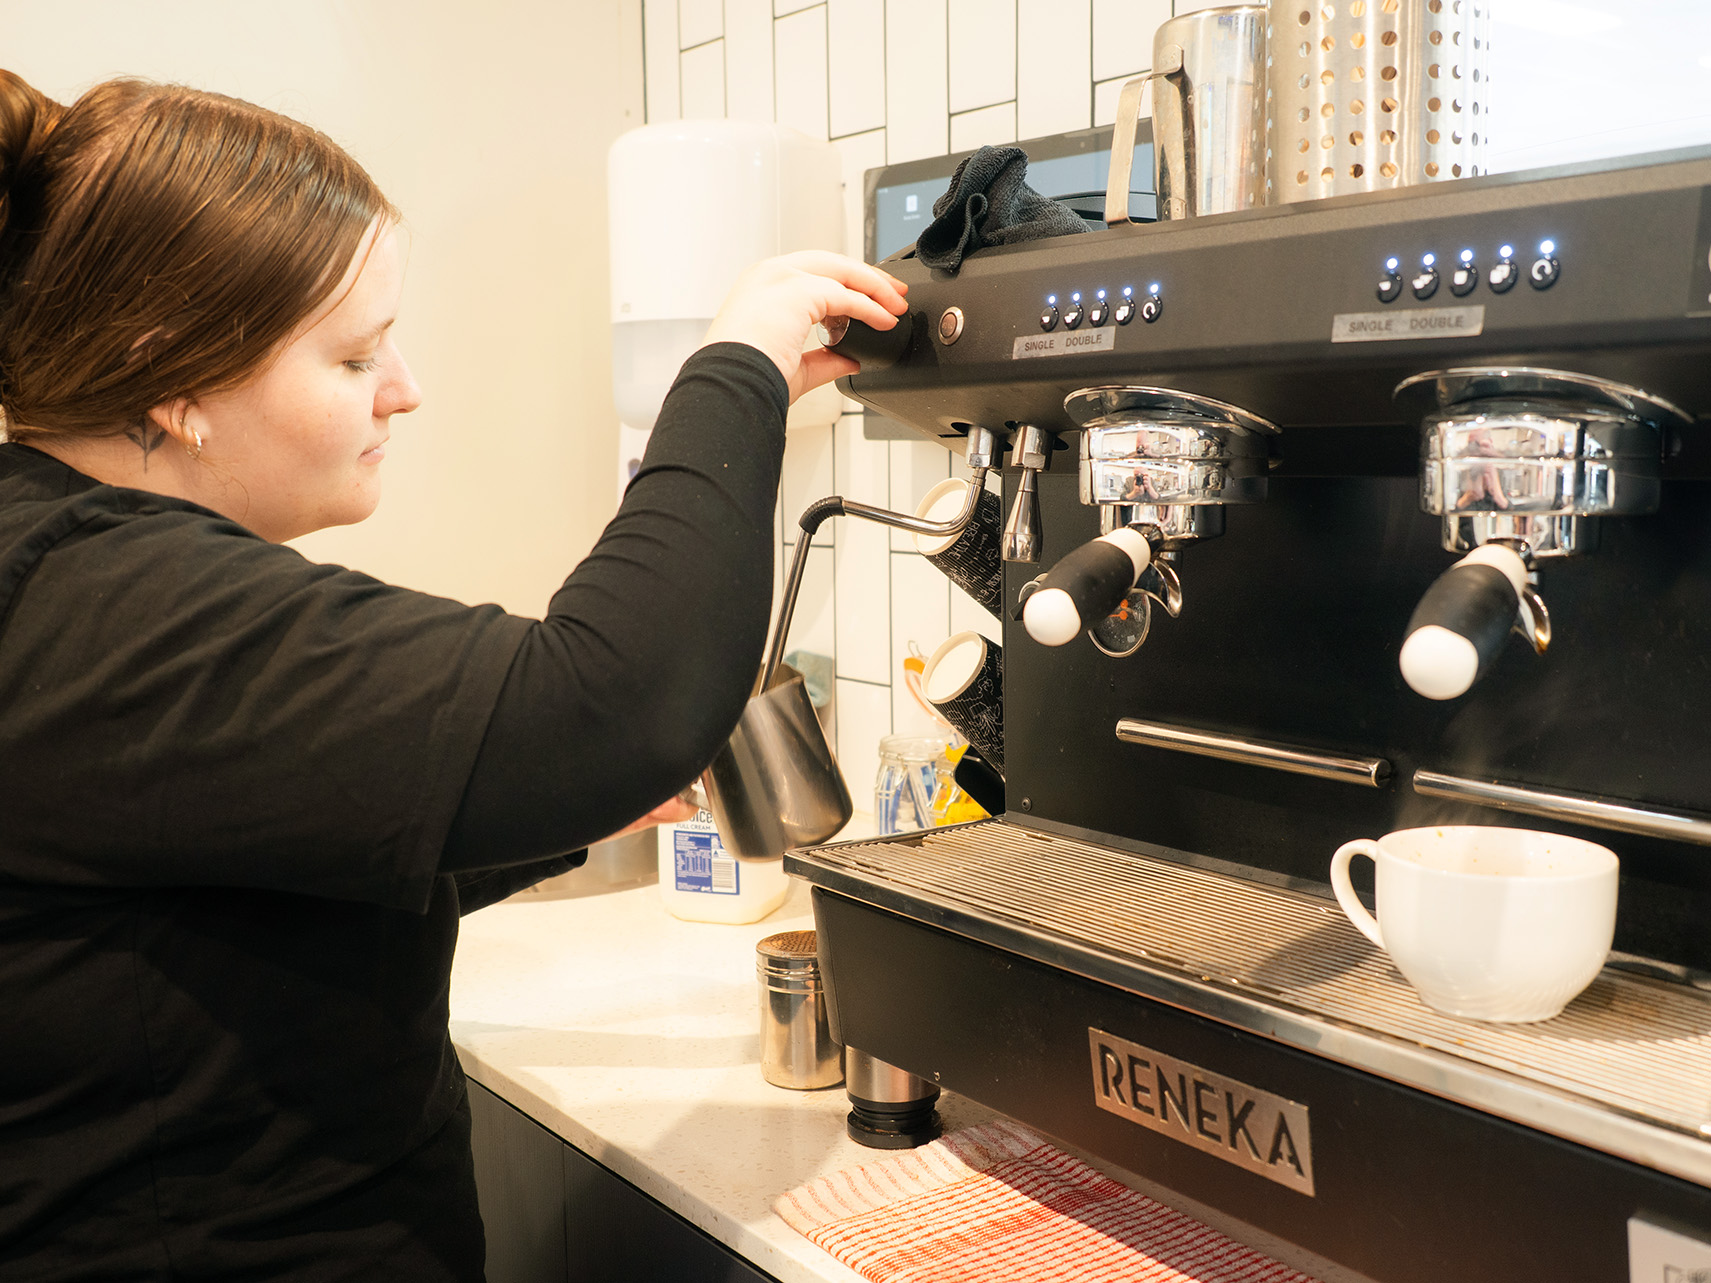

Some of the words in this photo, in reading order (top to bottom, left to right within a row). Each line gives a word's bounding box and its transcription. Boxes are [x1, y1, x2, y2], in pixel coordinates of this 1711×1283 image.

[1349, 319, 1393, 333] SINGLE
[1410, 315, 1463, 330] DOUBLE
[1024, 339, 1054, 351] SINGLE
[1065, 334, 1102, 347] DOUBLE
[948, 520, 980, 561] BREATHE
[1098, 1042, 1306, 1180] RENEKA
